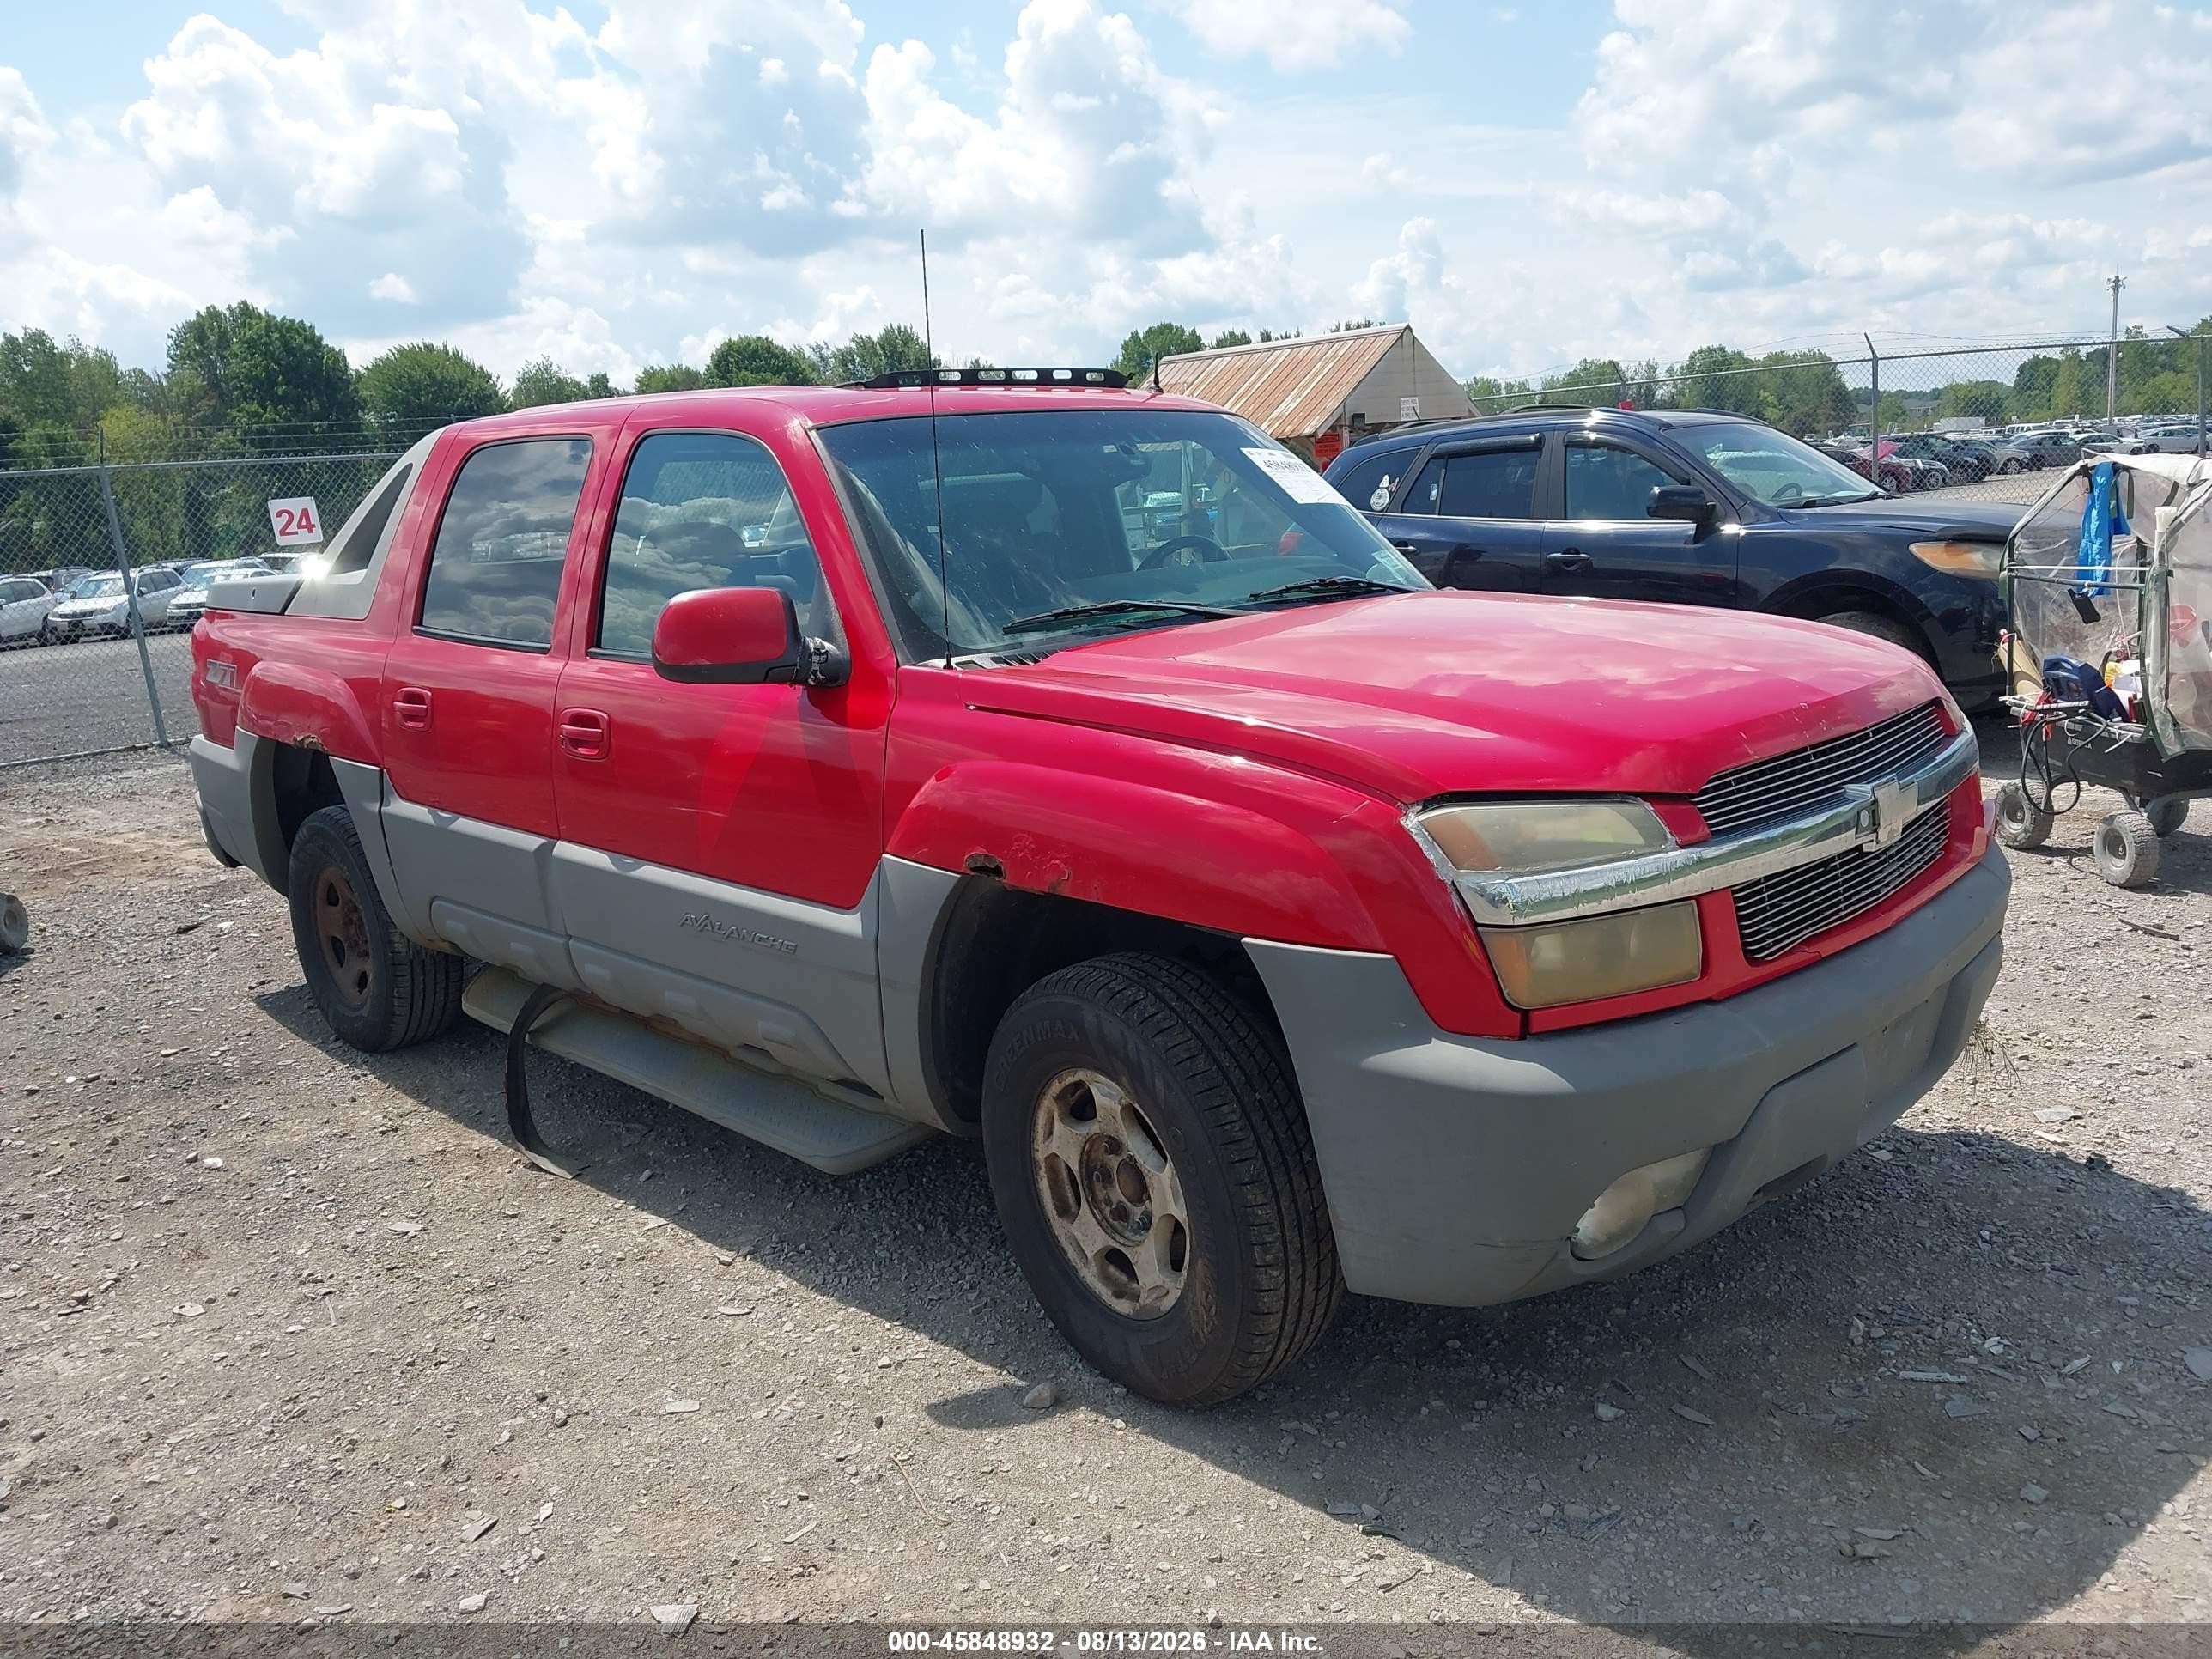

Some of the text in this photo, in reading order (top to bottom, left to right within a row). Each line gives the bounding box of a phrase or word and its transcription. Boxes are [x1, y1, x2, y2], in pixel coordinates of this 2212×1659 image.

[276, 507, 316, 537] 24
[679, 912, 798, 954] AVALANCHE
[995, 1018, 1080, 1092] GREENMAX
